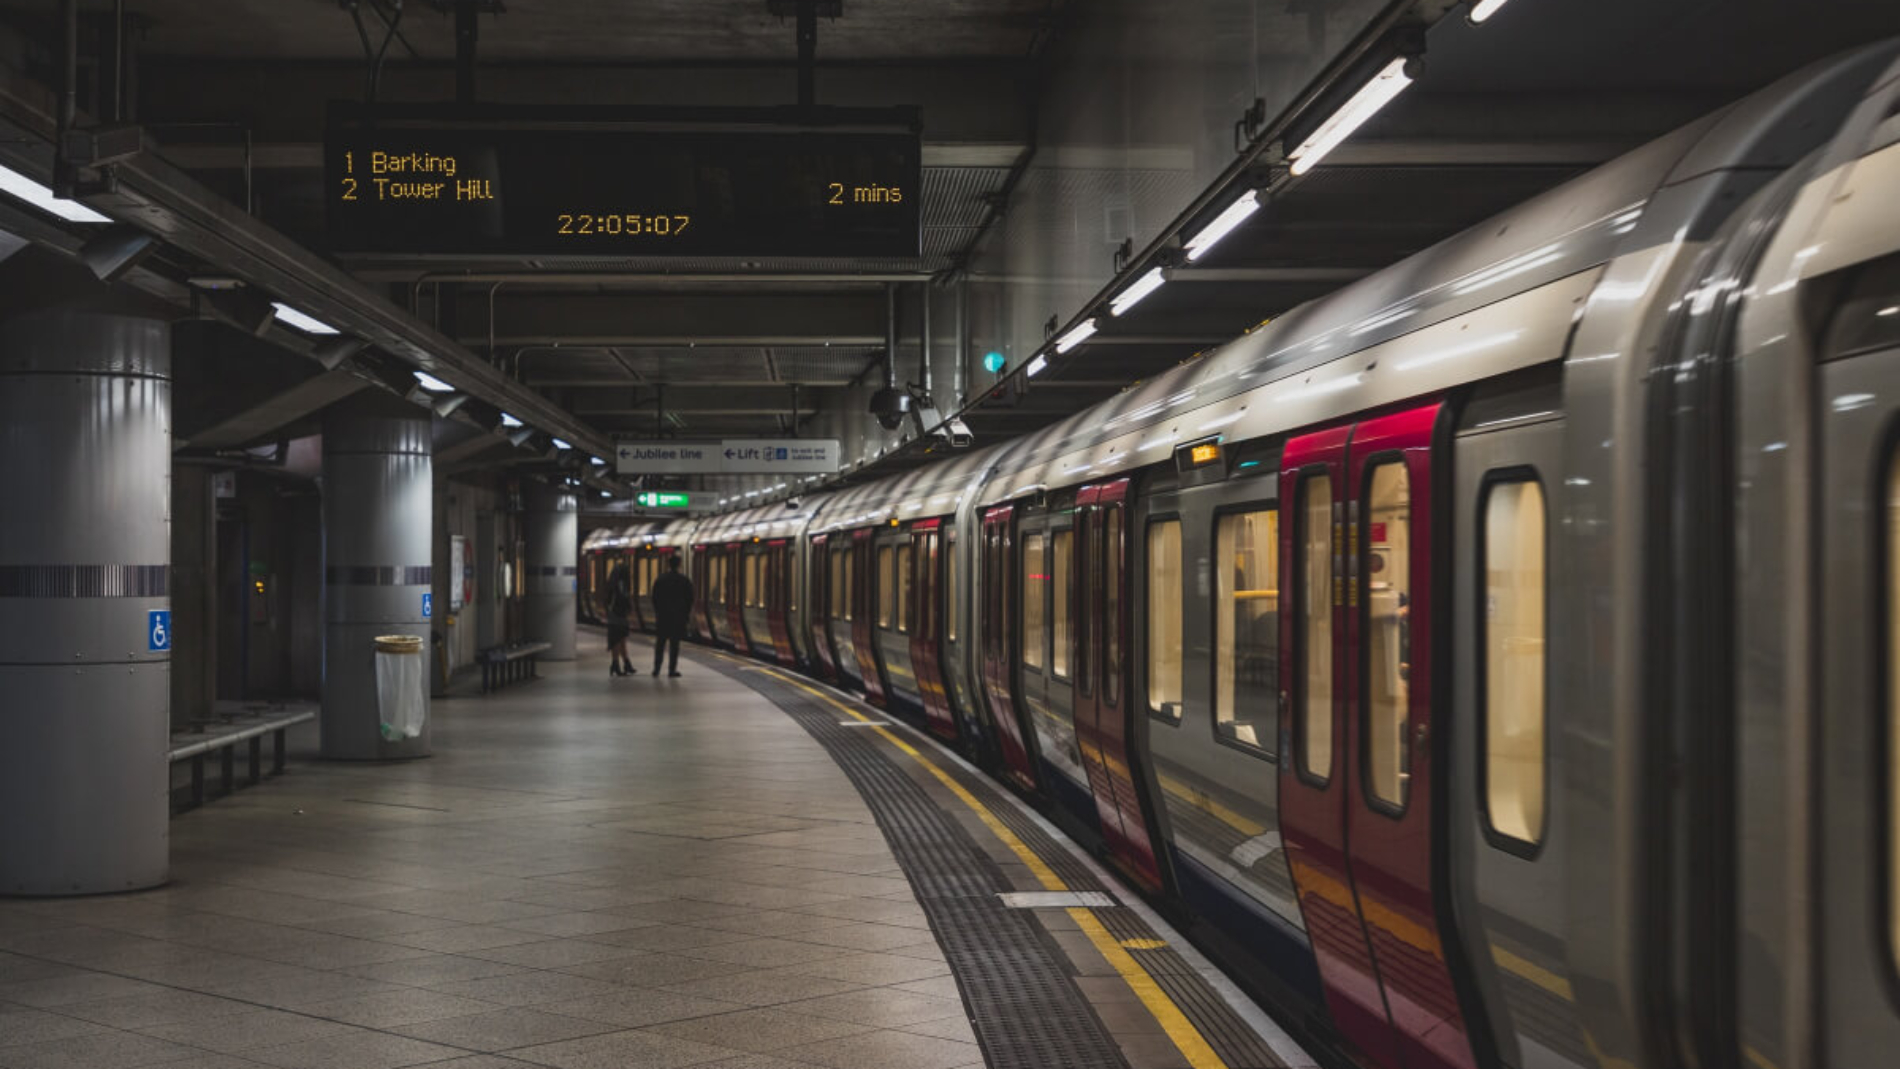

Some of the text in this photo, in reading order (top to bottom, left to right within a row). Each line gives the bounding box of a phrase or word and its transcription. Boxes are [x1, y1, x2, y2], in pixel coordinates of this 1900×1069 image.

[345, 151, 457, 177] 1 Barking
[341, 178, 902, 205] 2 Tower Hill 2 mins
[557, 214, 691, 236] 22:05:07
[633, 448, 703, 460] Jubilee line
[738, 448, 760, 460] Lift
